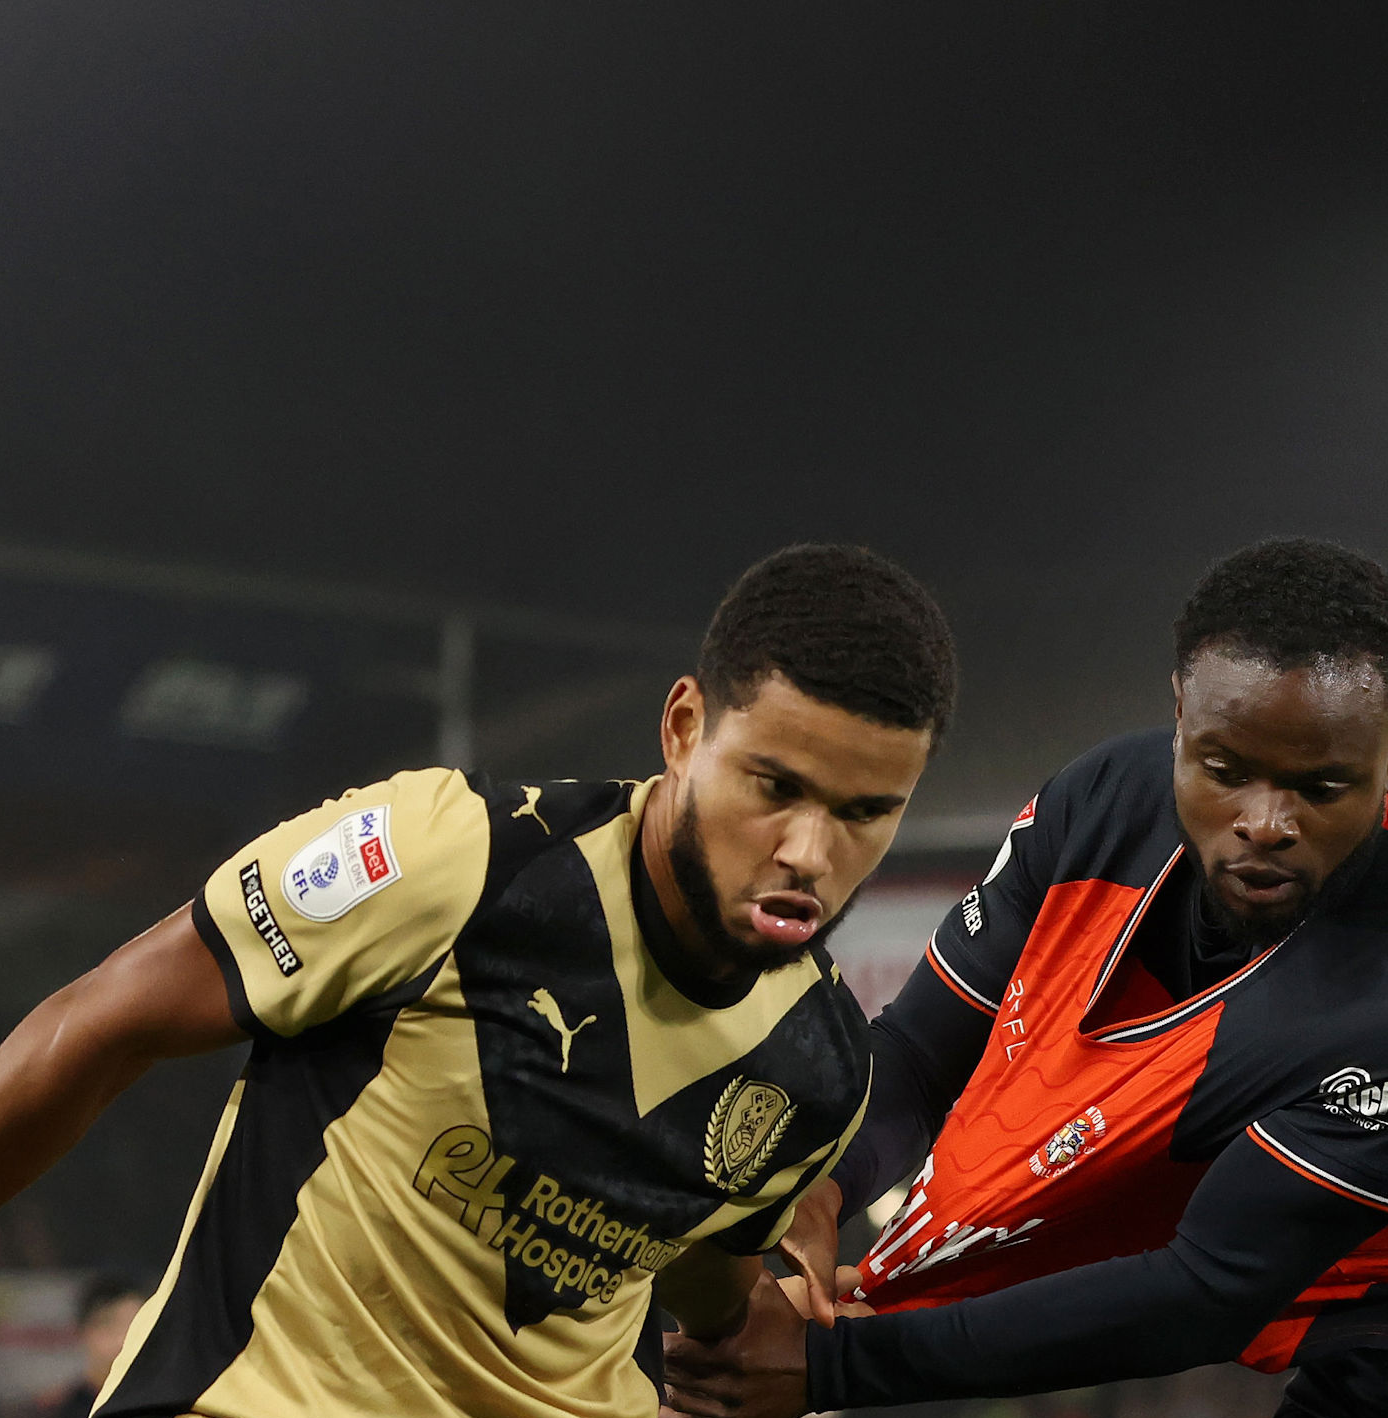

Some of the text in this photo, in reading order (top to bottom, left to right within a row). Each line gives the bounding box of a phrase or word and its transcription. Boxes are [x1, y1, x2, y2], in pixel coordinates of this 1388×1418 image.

[342, 821, 357, 862] LEAGUE
[359, 813, 385, 877] sky bet
[292, 869, 310, 900] EFL
[962, 884, 983, 936] ETHER
[520, 1174, 682, 1273] Rotherham
[488, 1214, 623, 1304] Hospice
